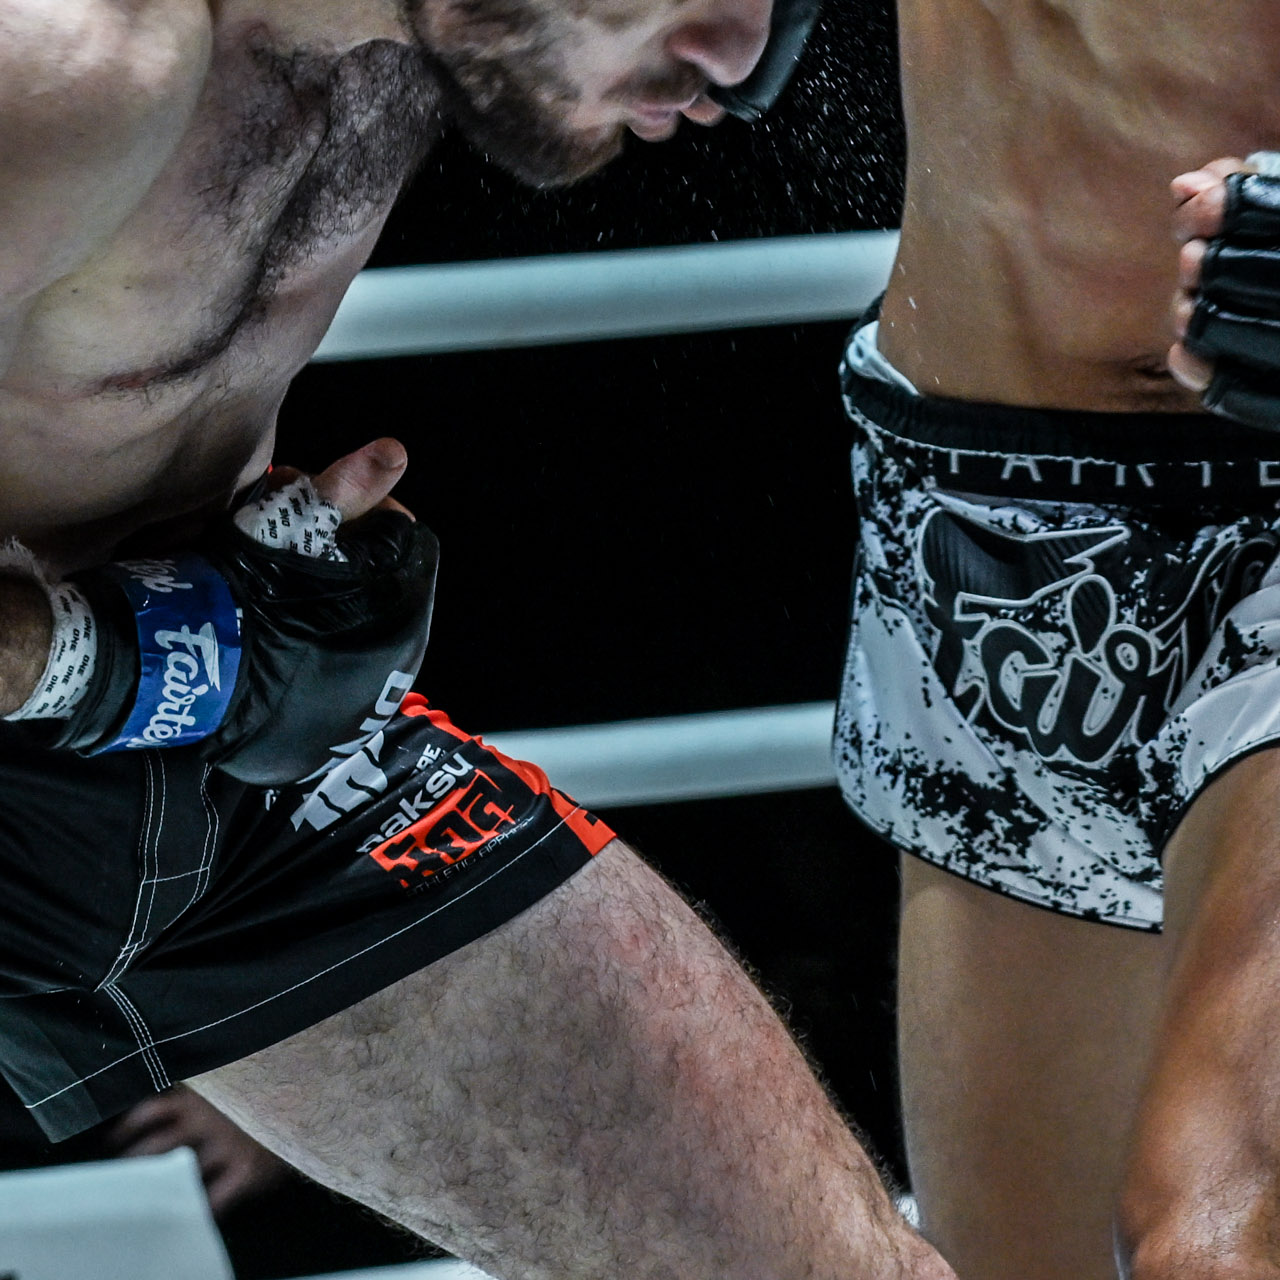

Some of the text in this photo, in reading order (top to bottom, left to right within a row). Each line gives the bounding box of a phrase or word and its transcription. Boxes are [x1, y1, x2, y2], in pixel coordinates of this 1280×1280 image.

[279, 507, 291, 527] ONE
[267, 518, 278, 539] ONE
[304, 529, 313, 554] ONE
[70, 628, 80, 652] ONE
[61, 665, 75, 685] ONE
[78, 654, 90, 676] ONE
[45, 675, 59, 693] ONE
